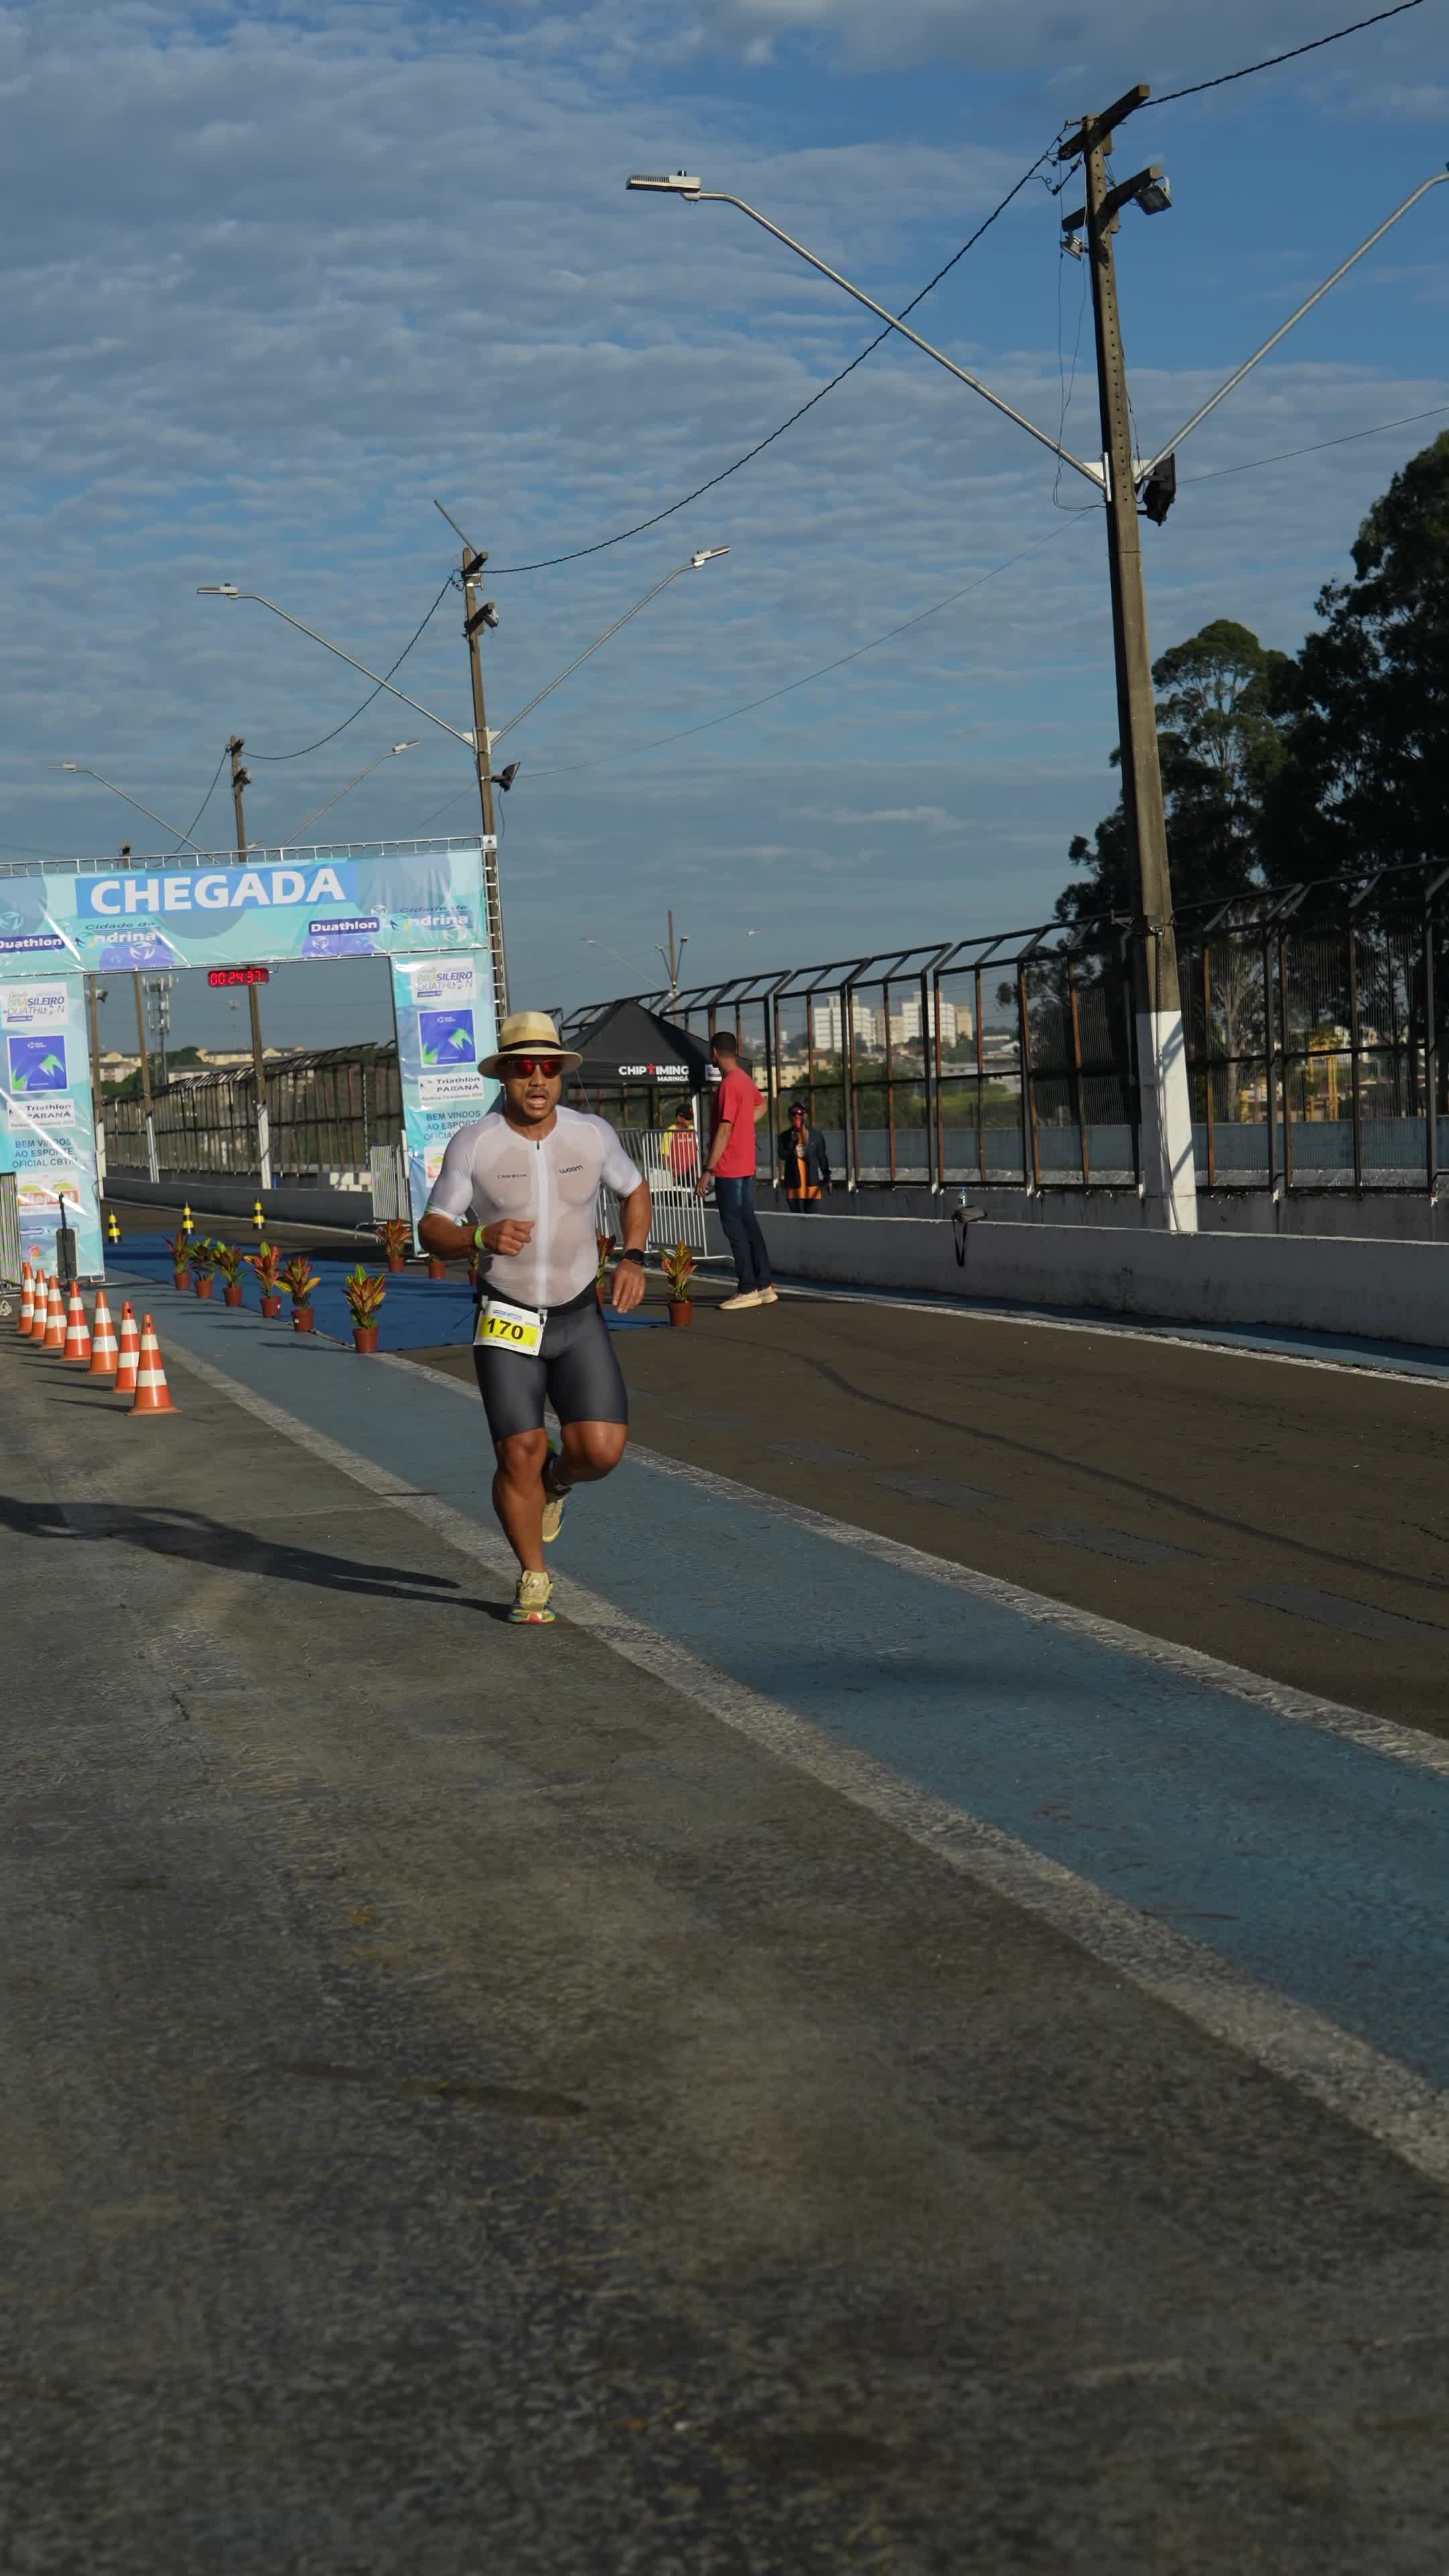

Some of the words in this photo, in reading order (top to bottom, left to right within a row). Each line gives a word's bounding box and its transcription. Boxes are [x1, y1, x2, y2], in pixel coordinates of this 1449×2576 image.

[91, 869, 346, 914] CHEGADA
[311, 921, 378, 933] Duathlon
[210, 972, 226, 985] 00
[228, 971, 245, 985] 24
[247, 970, 262, 984] 37
[619, 1065, 647, 1075] CHIP
[426, 1113, 445, 1121] BEM
[447, 1110, 481, 1120] VINDOS
[425, 1122, 439, 1131] AO
[441, 1120, 478, 1130] ESPORT
[424, 1132, 454, 1140] OFICIA
[15, 1140, 35, 1148] BEM
[38, 1138, 71, 1147] VIOS
[15, 1150, 28, 1159] AO
[31, 1148, 73, 1157] ESPOE
[12, 1159, 48, 1169] OFICIAL
[487, 1318, 524, 1340] 170
